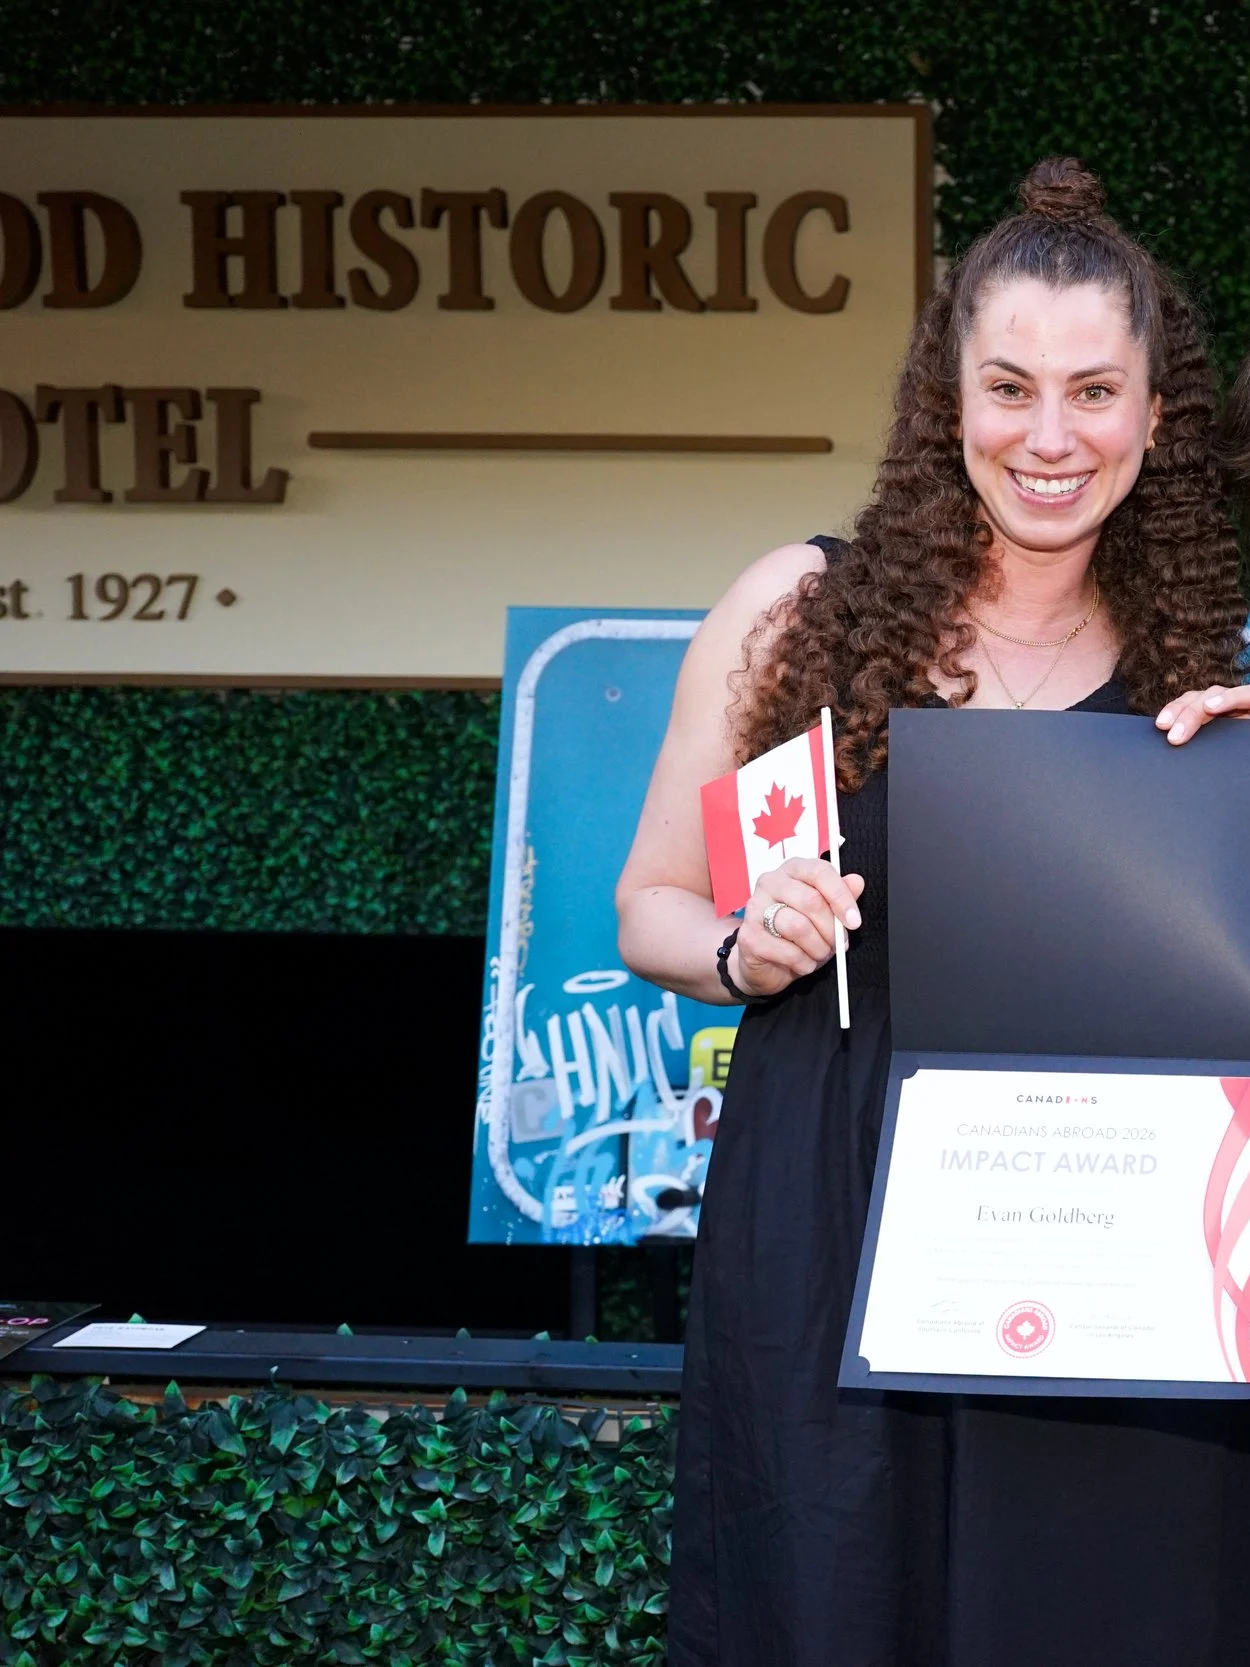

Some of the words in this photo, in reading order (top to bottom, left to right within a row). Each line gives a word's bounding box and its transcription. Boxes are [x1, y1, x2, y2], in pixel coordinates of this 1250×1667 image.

[179, 187, 853, 315] HISTORIC
[66, 573, 200, 622] 1927
[956, 1123, 1048, 1140] CANADIANS
[1051, 1125, 1119, 1141] ABROAD
[1121, 1127, 1158, 1141] 2026
[940, 1148, 1046, 1173] IMPACT
[1053, 1151, 1159, 1176] AWARD
[976, 1204, 1023, 1225] Evan
[1028, 1205, 1116, 1230] Goldberg
